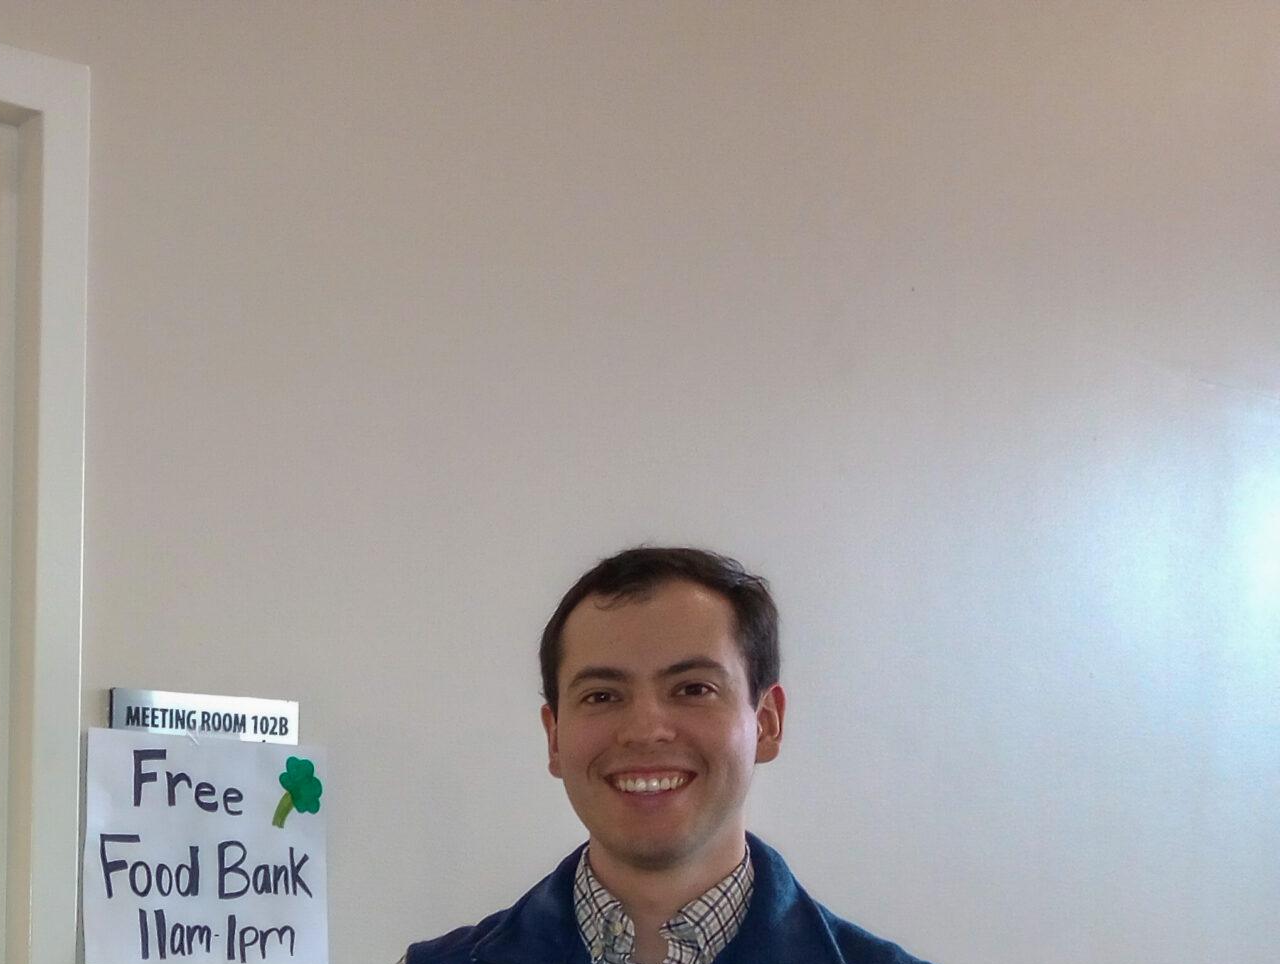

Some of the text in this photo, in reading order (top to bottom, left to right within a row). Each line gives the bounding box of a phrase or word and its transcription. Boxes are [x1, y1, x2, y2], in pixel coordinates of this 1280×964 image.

[125, 705, 289, 736] MEETING ROOM 102B
[133, 749, 243, 815] Free
[100, 834, 313, 899] Food Bank
